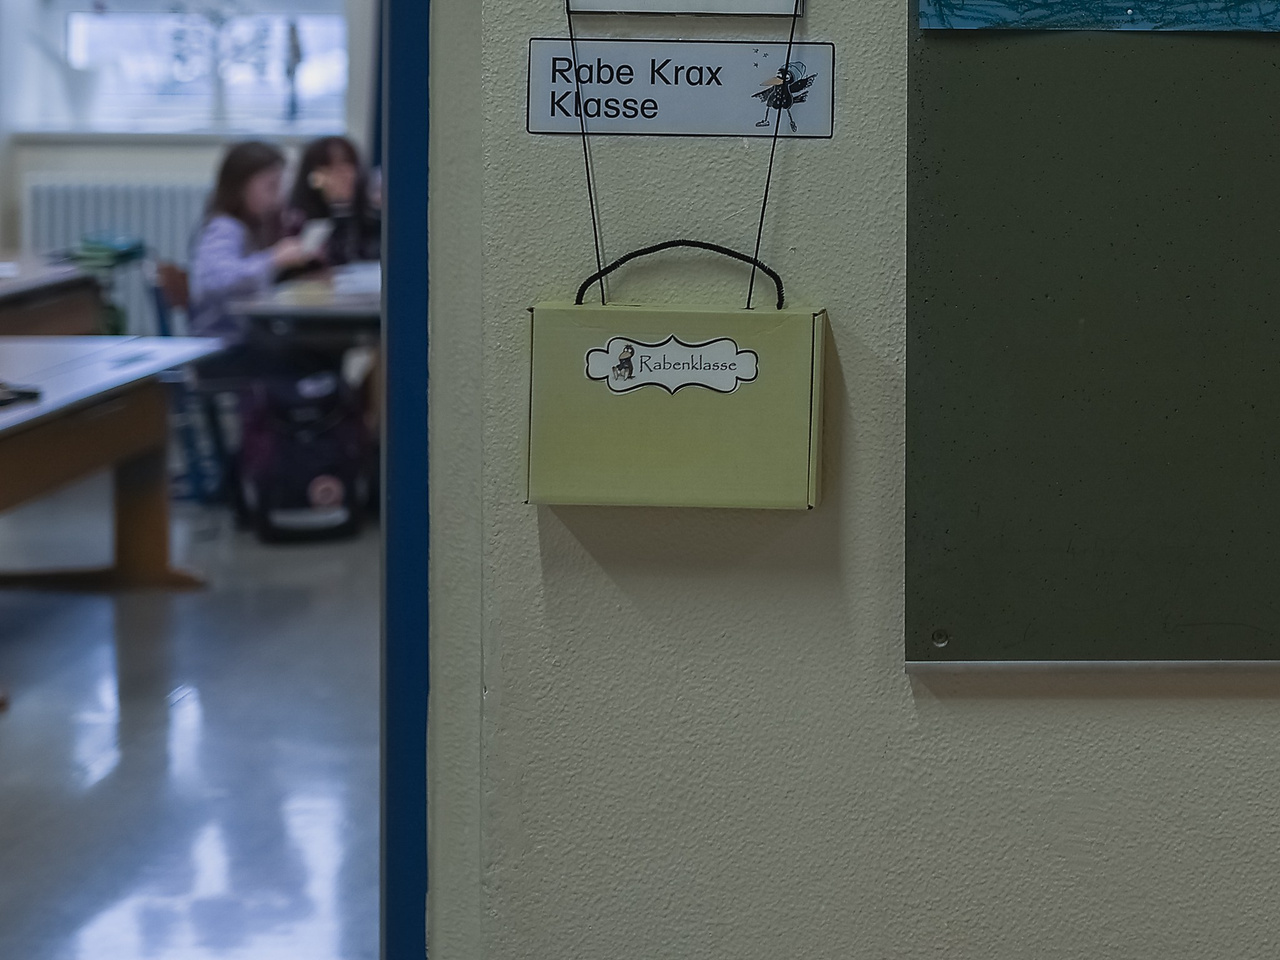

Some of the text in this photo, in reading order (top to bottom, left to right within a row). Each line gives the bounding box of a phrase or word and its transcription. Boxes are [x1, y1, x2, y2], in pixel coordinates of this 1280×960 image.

[551, 57, 723, 86] Rabe Krax
[550, 91, 659, 119] Klasse
[639, 354, 737, 373] Rabenklasse
